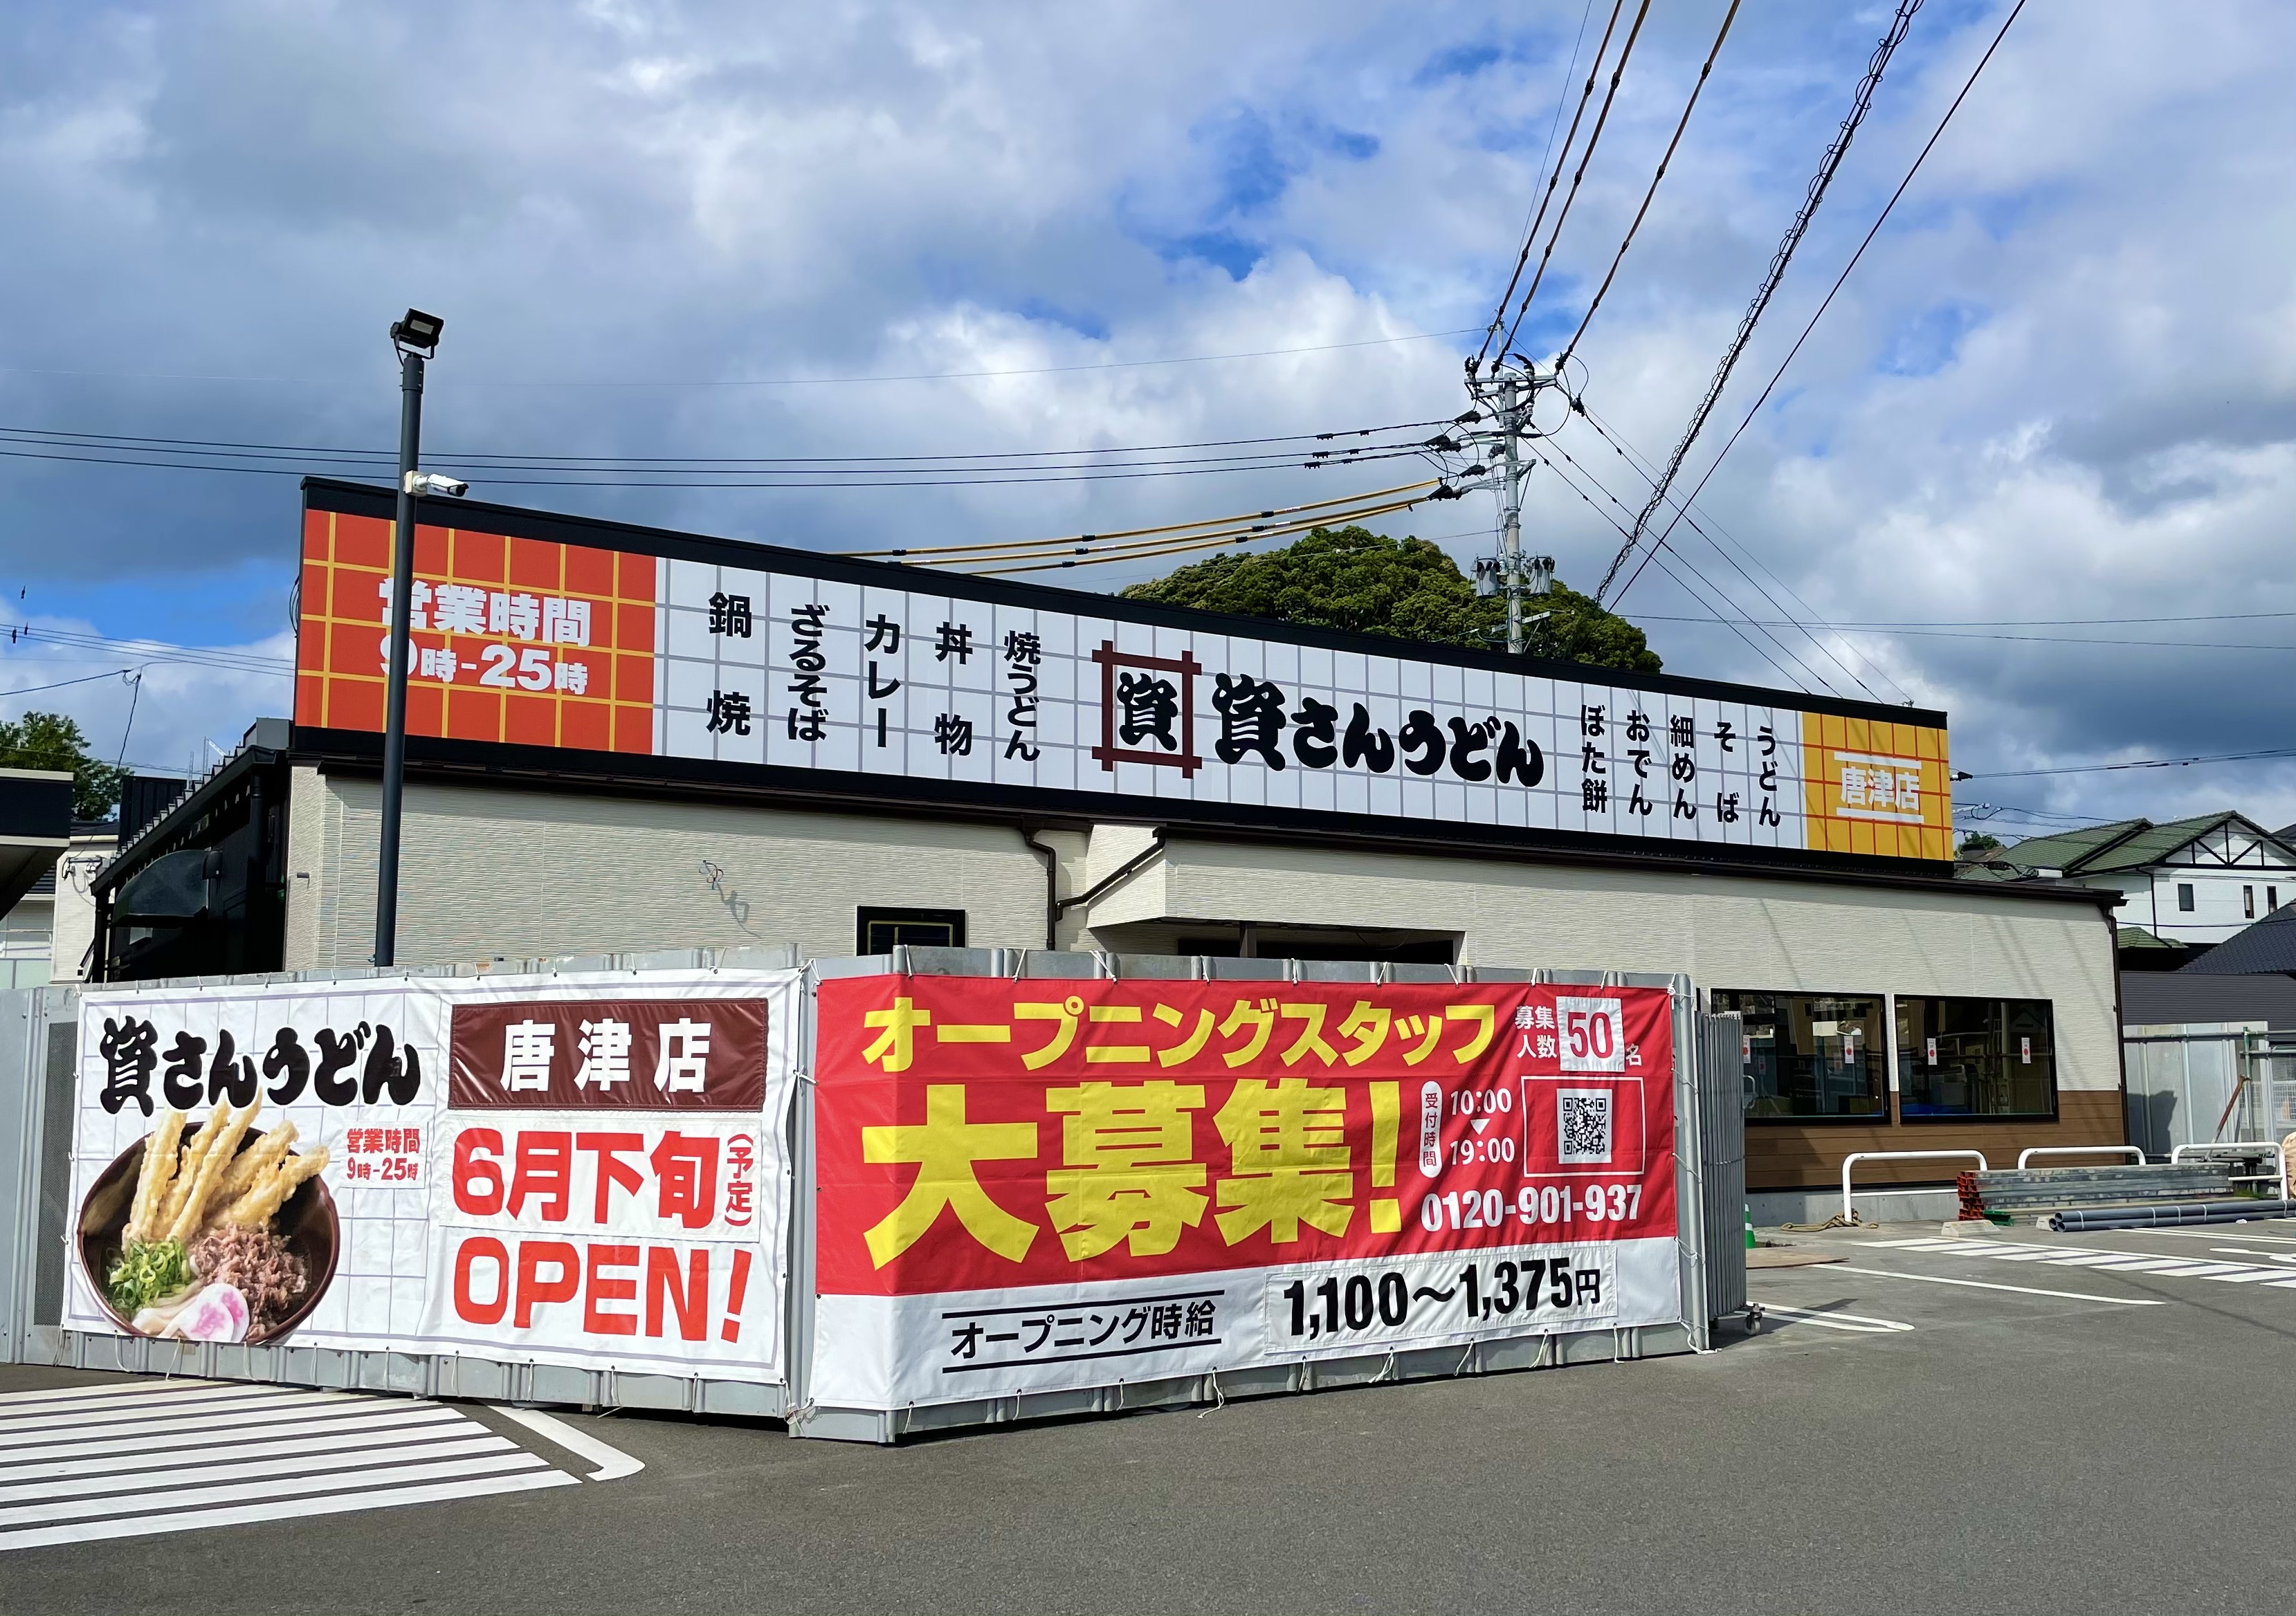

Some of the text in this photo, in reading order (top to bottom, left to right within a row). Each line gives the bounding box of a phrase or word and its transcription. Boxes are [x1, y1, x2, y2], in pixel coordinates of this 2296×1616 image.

[379, 577, 591, 648] 営業時間
[787, 604, 830, 742] ざるそば
[864, 614, 901, 748] カレー
[1003, 630, 1041, 762] 焼うどん
[1116, 672, 1178, 751] 資
[1212, 672, 1545, 787] 資さんうどん
[1580, 704, 1608, 814] ぼた餅
[1625, 709, 1653, 816] おでん
[1670, 713, 1697, 820] 細めん
[1756, 725, 1781, 827] うどん
[1841, 766, 1920, 811] 唐津店
[500, 1018, 712, 1093] 唐津店
[862, 995, 1495, 1072] オープニングスタッフ
[1515, 1005, 1556, 1031] 募集
[1517, 1034, 1558, 1060] 人数
[1567, 1011, 1614, 1058] 50
[1625, 1043, 1643, 1066] 名
[99, 1015, 421, 1118] 資さんうどん
[1450, 1087, 1513, 1116] 10:00
[347, 1128, 421, 1155] 営業時間
[1423, 1092, 1439, 1167] 受付時間
[1450, 1137, 1515, 1165] 19:00
[347, 1157, 419, 1182] 9時-25時
[453, 1128, 720, 1229] 6月下旬
[861, 1078, 1403, 1271] 大募集!
[1421, 1184, 1642, 1232] 0120-901-937
[454, 1236, 752, 1344] OPEN!
[951, 1298, 1217, 1359] オープニング時給
